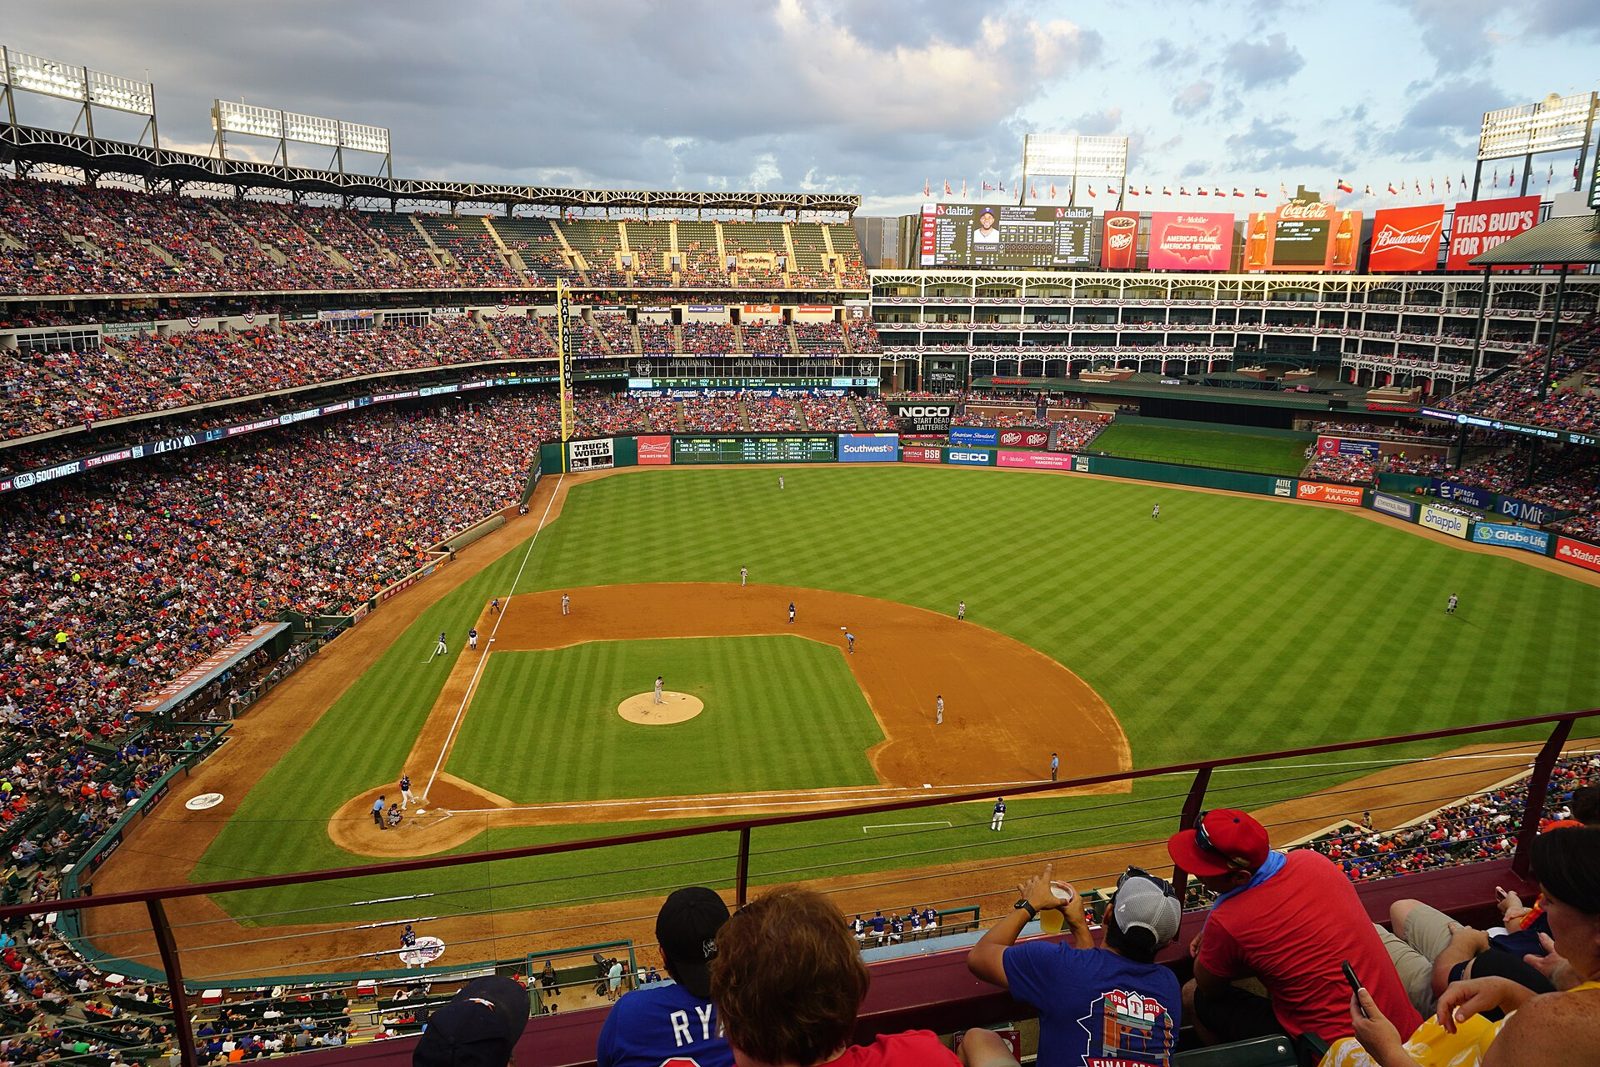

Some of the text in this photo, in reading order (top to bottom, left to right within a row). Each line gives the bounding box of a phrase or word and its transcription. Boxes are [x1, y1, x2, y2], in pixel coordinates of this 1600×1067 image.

[1456, 210, 1533, 234] THIS BUD'S
[1167, 235, 1198, 243] AMERICA'S
[1378, 228, 1431, 246] Budweiser
[1452, 237, 1479, 256] FOR
[564, 355, 572, 388] FOWL
[898, 406, 951, 418] NOCO
[913, 417, 933, 425] START
[574, 442, 609, 451] TRUCK
[843, 444, 887, 453] Southwest
[574, 448, 610, 457] WORLD
[924, 449, 940, 459] BSB
[949, 452, 989, 462] GEICO
[87, 450, 131, 467] STREAMING ON
[1325, 486, 1360, 496] Insurance
[1325, 494, 1359, 504] AAA.com
[1424, 509, 1462, 532] Snapple
[1110, 994, 1127, 1005] 1994
[1144, 1003, 1160, 1014] 2019
